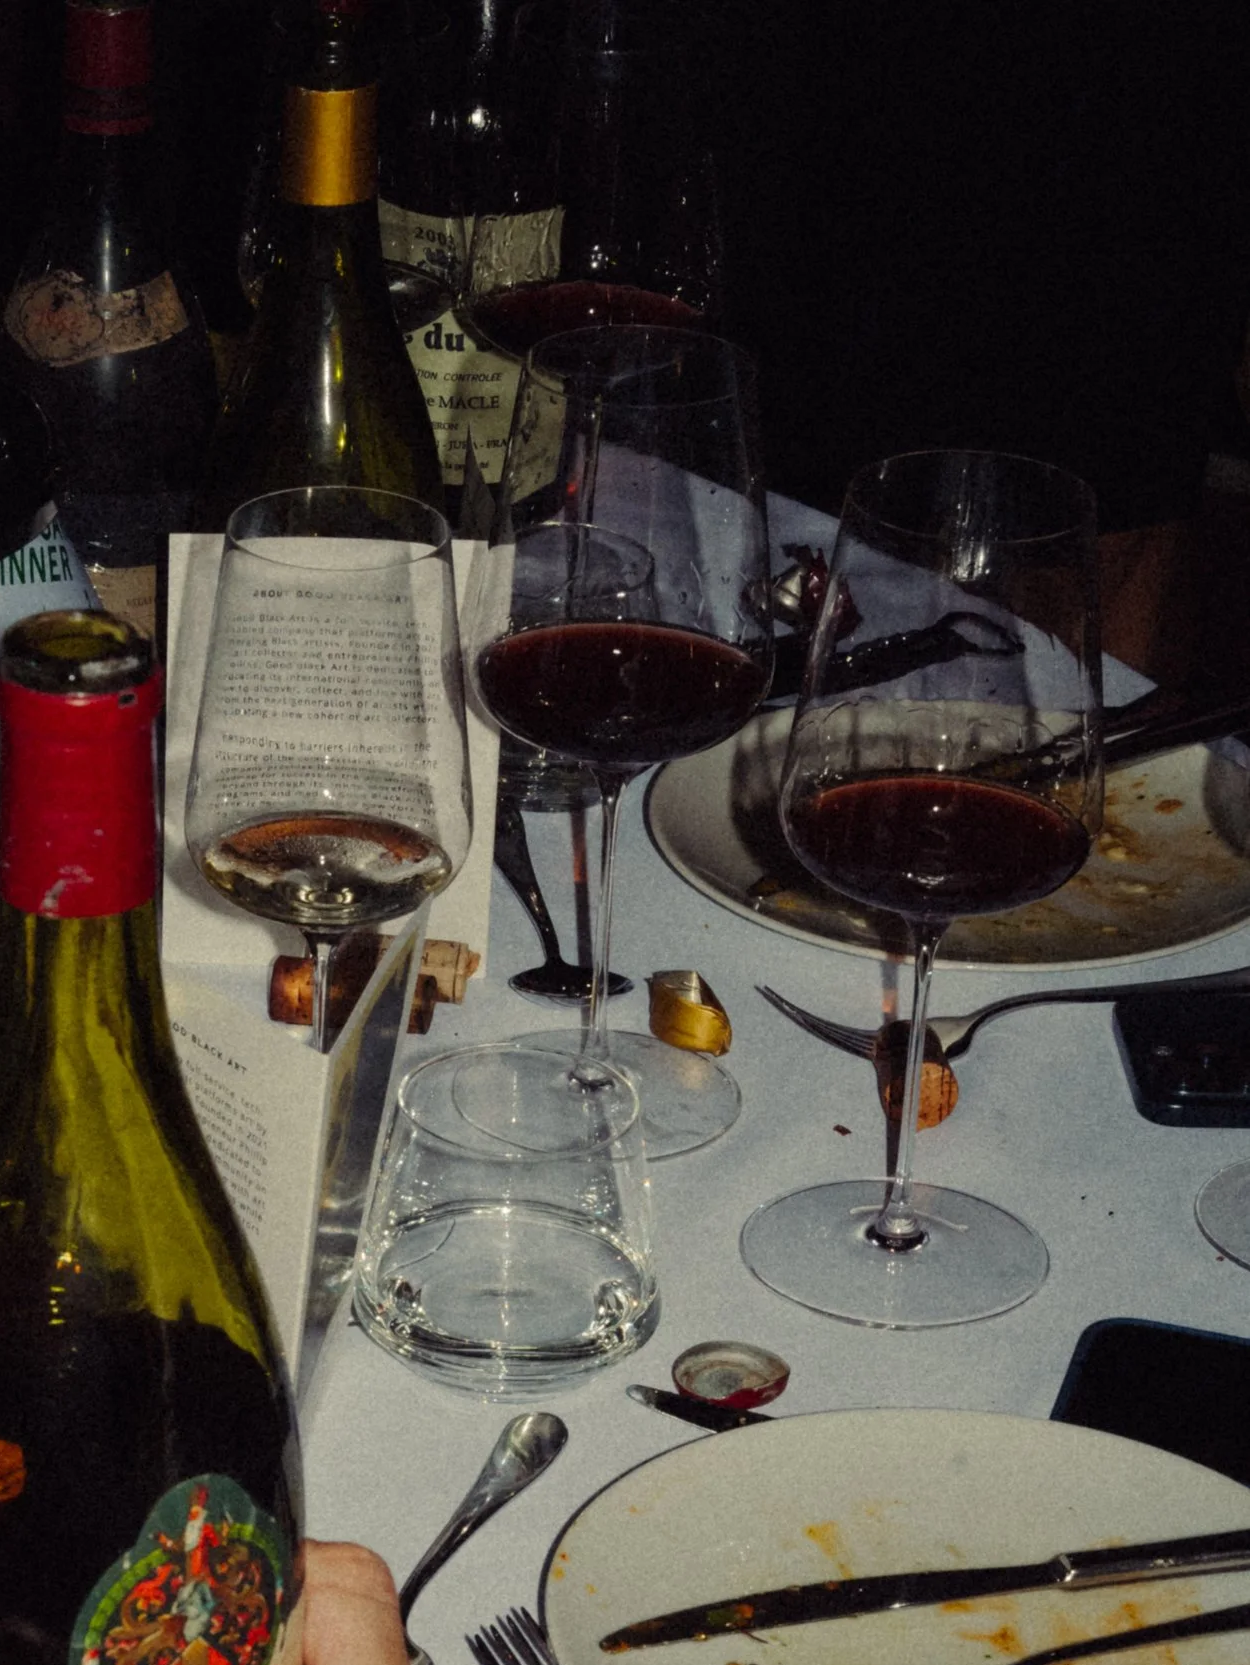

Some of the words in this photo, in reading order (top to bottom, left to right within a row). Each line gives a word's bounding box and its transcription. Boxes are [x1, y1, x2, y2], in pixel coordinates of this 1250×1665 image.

[424, 322, 465, 352] du
[439, 395, 501, 410] MACLE
[191, 1033, 224, 1061] BLACK
[226, 1057, 248, 1075] ART
